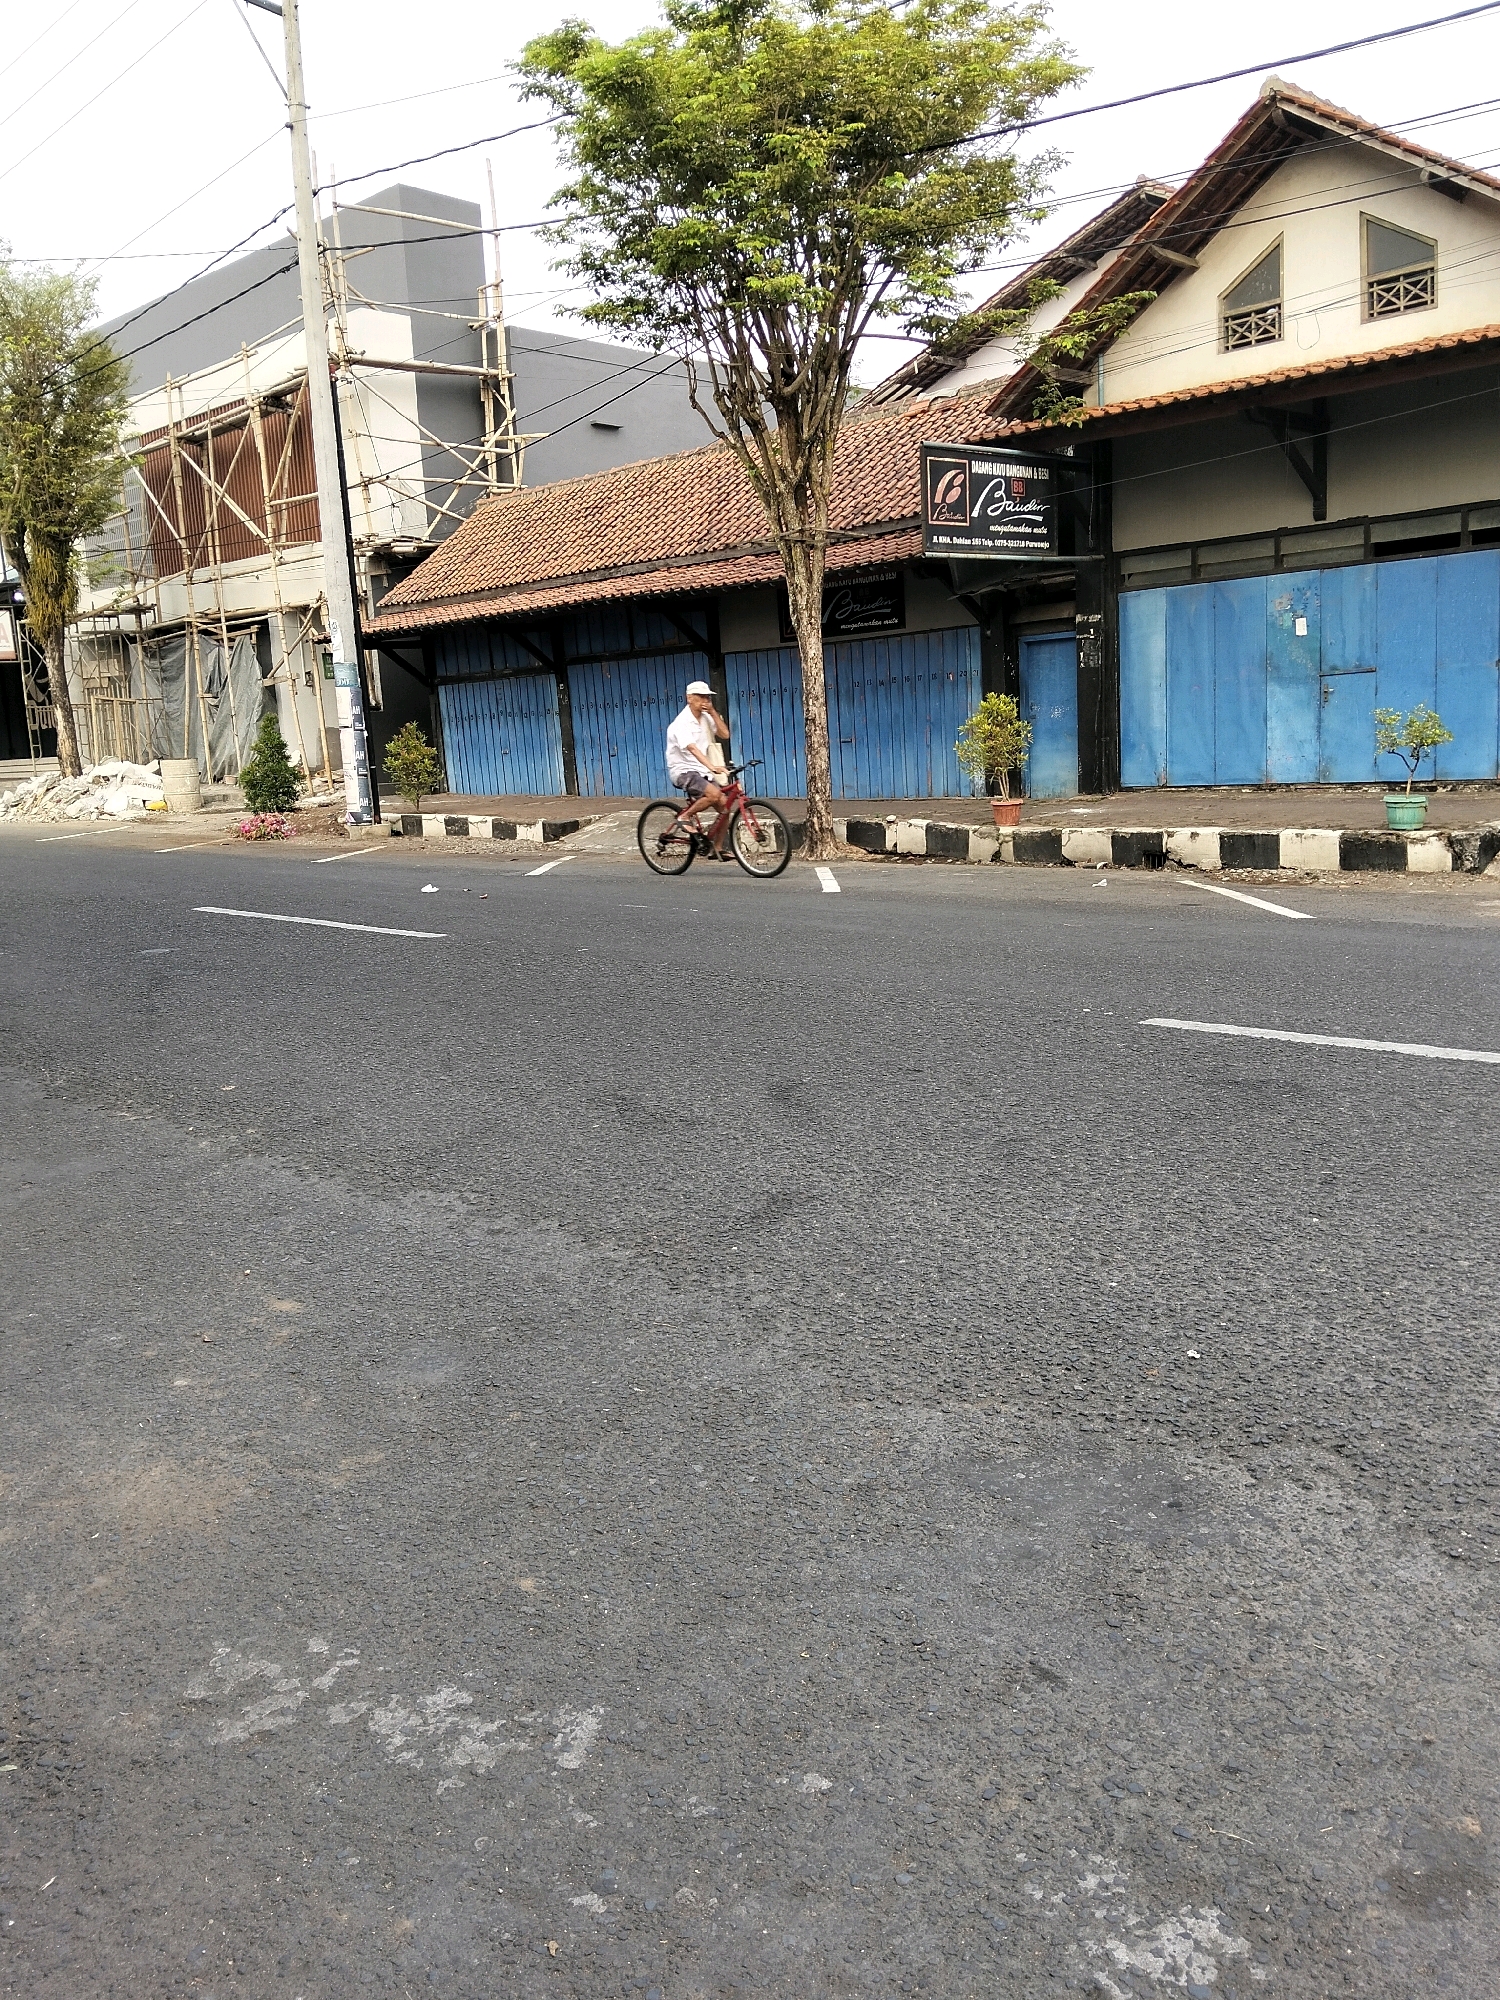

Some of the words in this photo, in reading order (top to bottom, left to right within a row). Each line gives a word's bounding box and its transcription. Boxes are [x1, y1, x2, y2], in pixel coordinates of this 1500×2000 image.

[971, 460, 992, 475] DAGANG
[993, 462, 1006, 476] KAYU
[1006, 464, 1032, 478] BANGUNAN
[1033, 467, 1037, 479] &
[1038, 468, 1049, 479] BESI
[1013, 481, 1023, 493] BB
[989, 523, 1032, 535] mengutamakan
[952, 536, 971, 544] Dahlan
